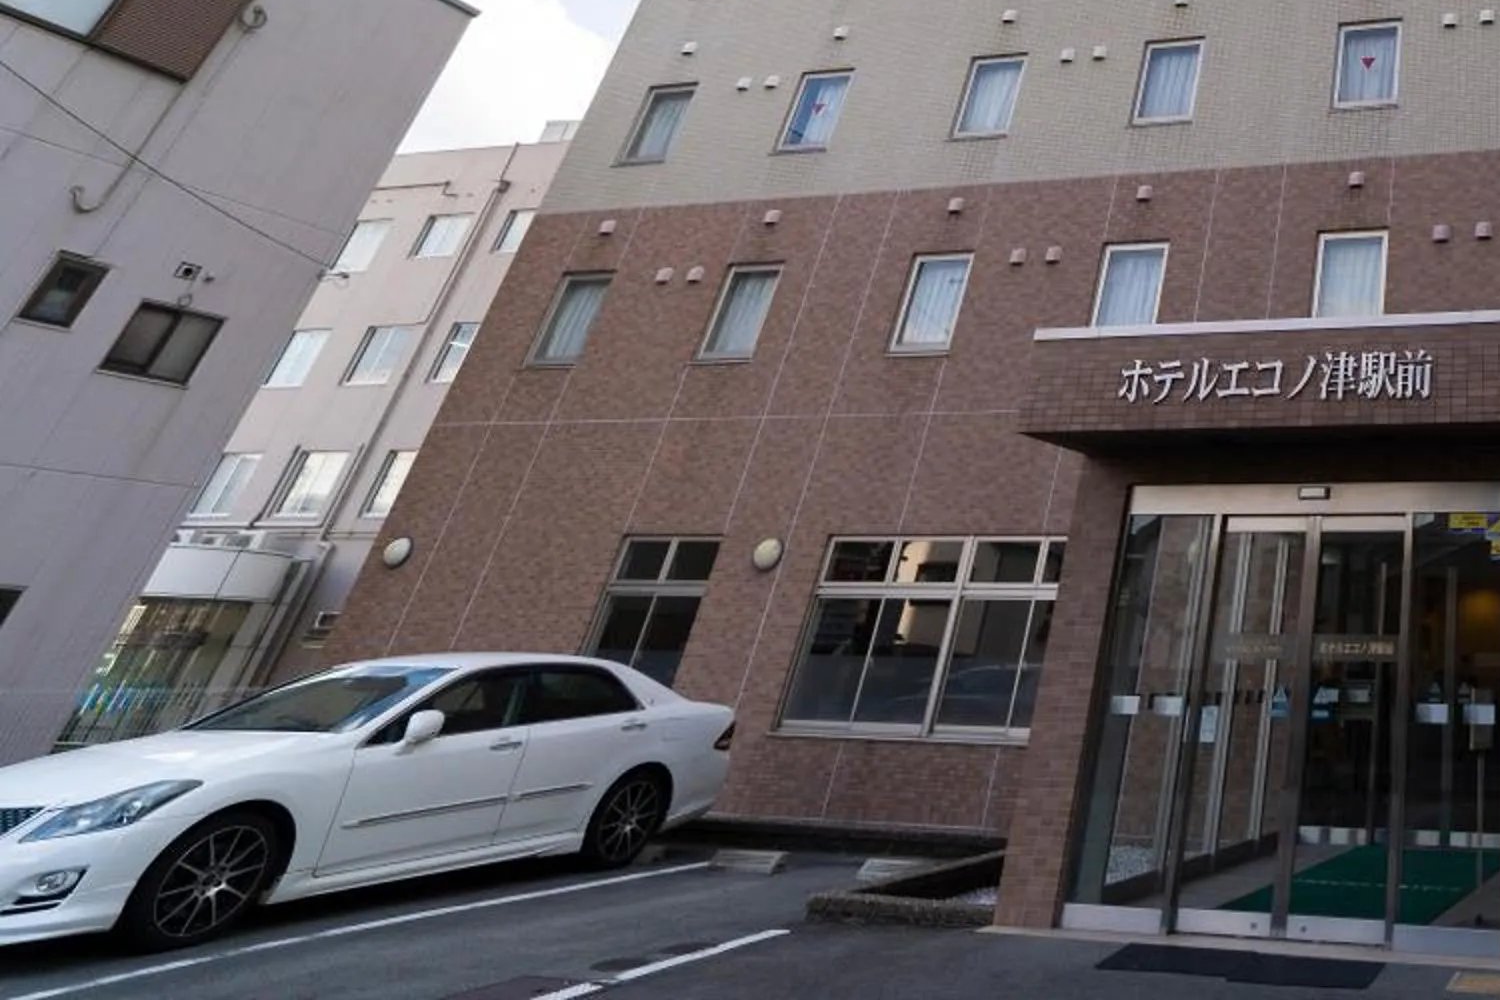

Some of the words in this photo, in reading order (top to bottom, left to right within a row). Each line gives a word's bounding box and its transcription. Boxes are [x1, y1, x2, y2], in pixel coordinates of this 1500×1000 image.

[1118, 349, 1433, 404] ホテルエコノ津駅前
